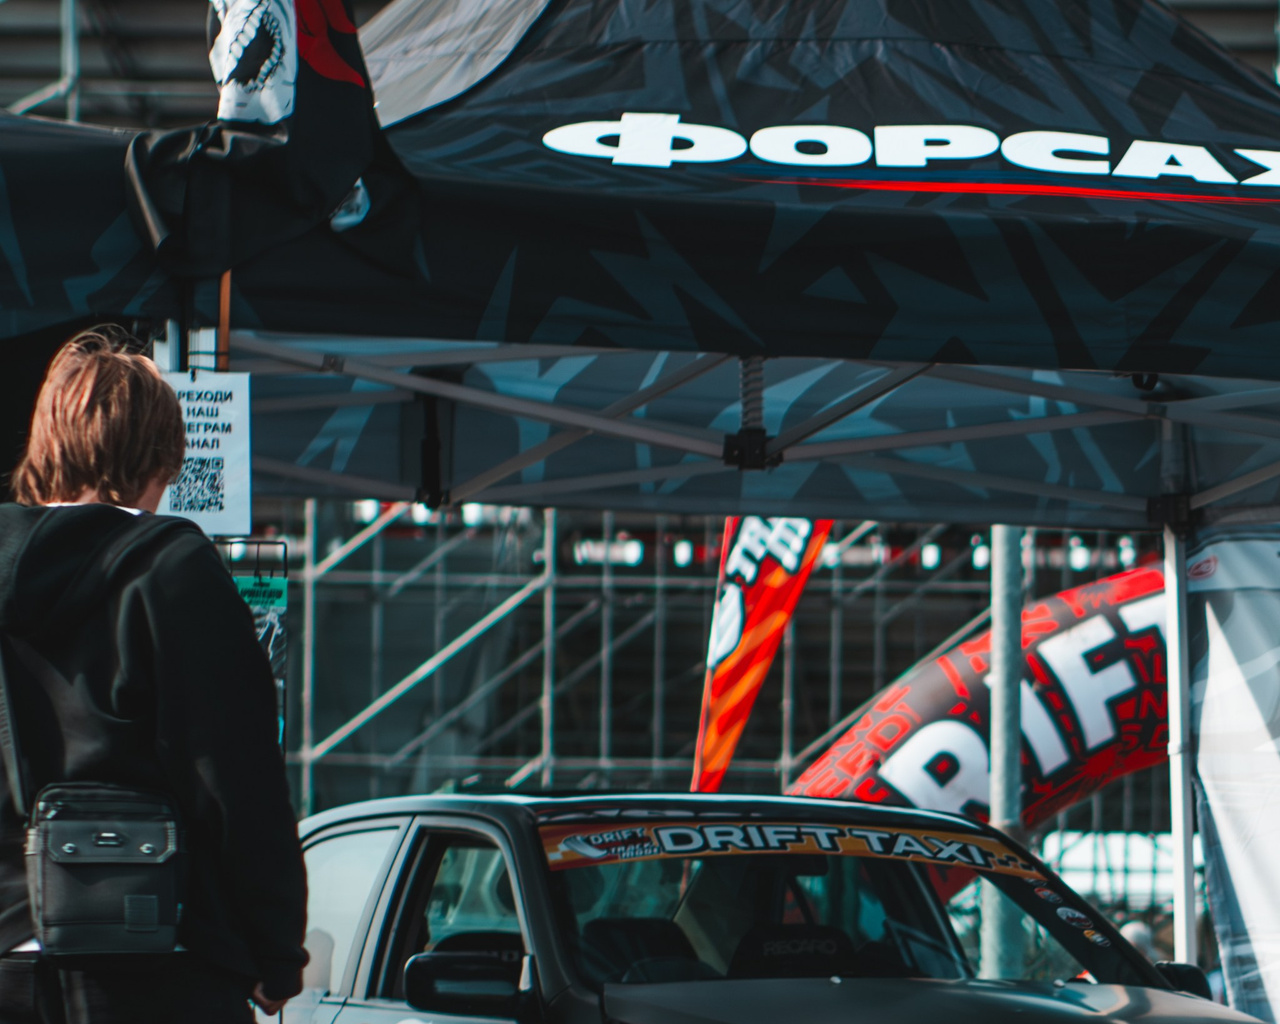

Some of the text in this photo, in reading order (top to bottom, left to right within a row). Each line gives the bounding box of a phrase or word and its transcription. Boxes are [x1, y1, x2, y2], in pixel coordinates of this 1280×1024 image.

[177, 390, 233, 403] РЕХОДИ
[184, 422, 232, 434] ЕГРАМ
[185, 437, 220, 449] АНАЛ
[589, 826, 646, 846] DRIFT
[660, 825, 987, 867] DRIFT TAXI
[763, 939, 838, 956] RECARO
